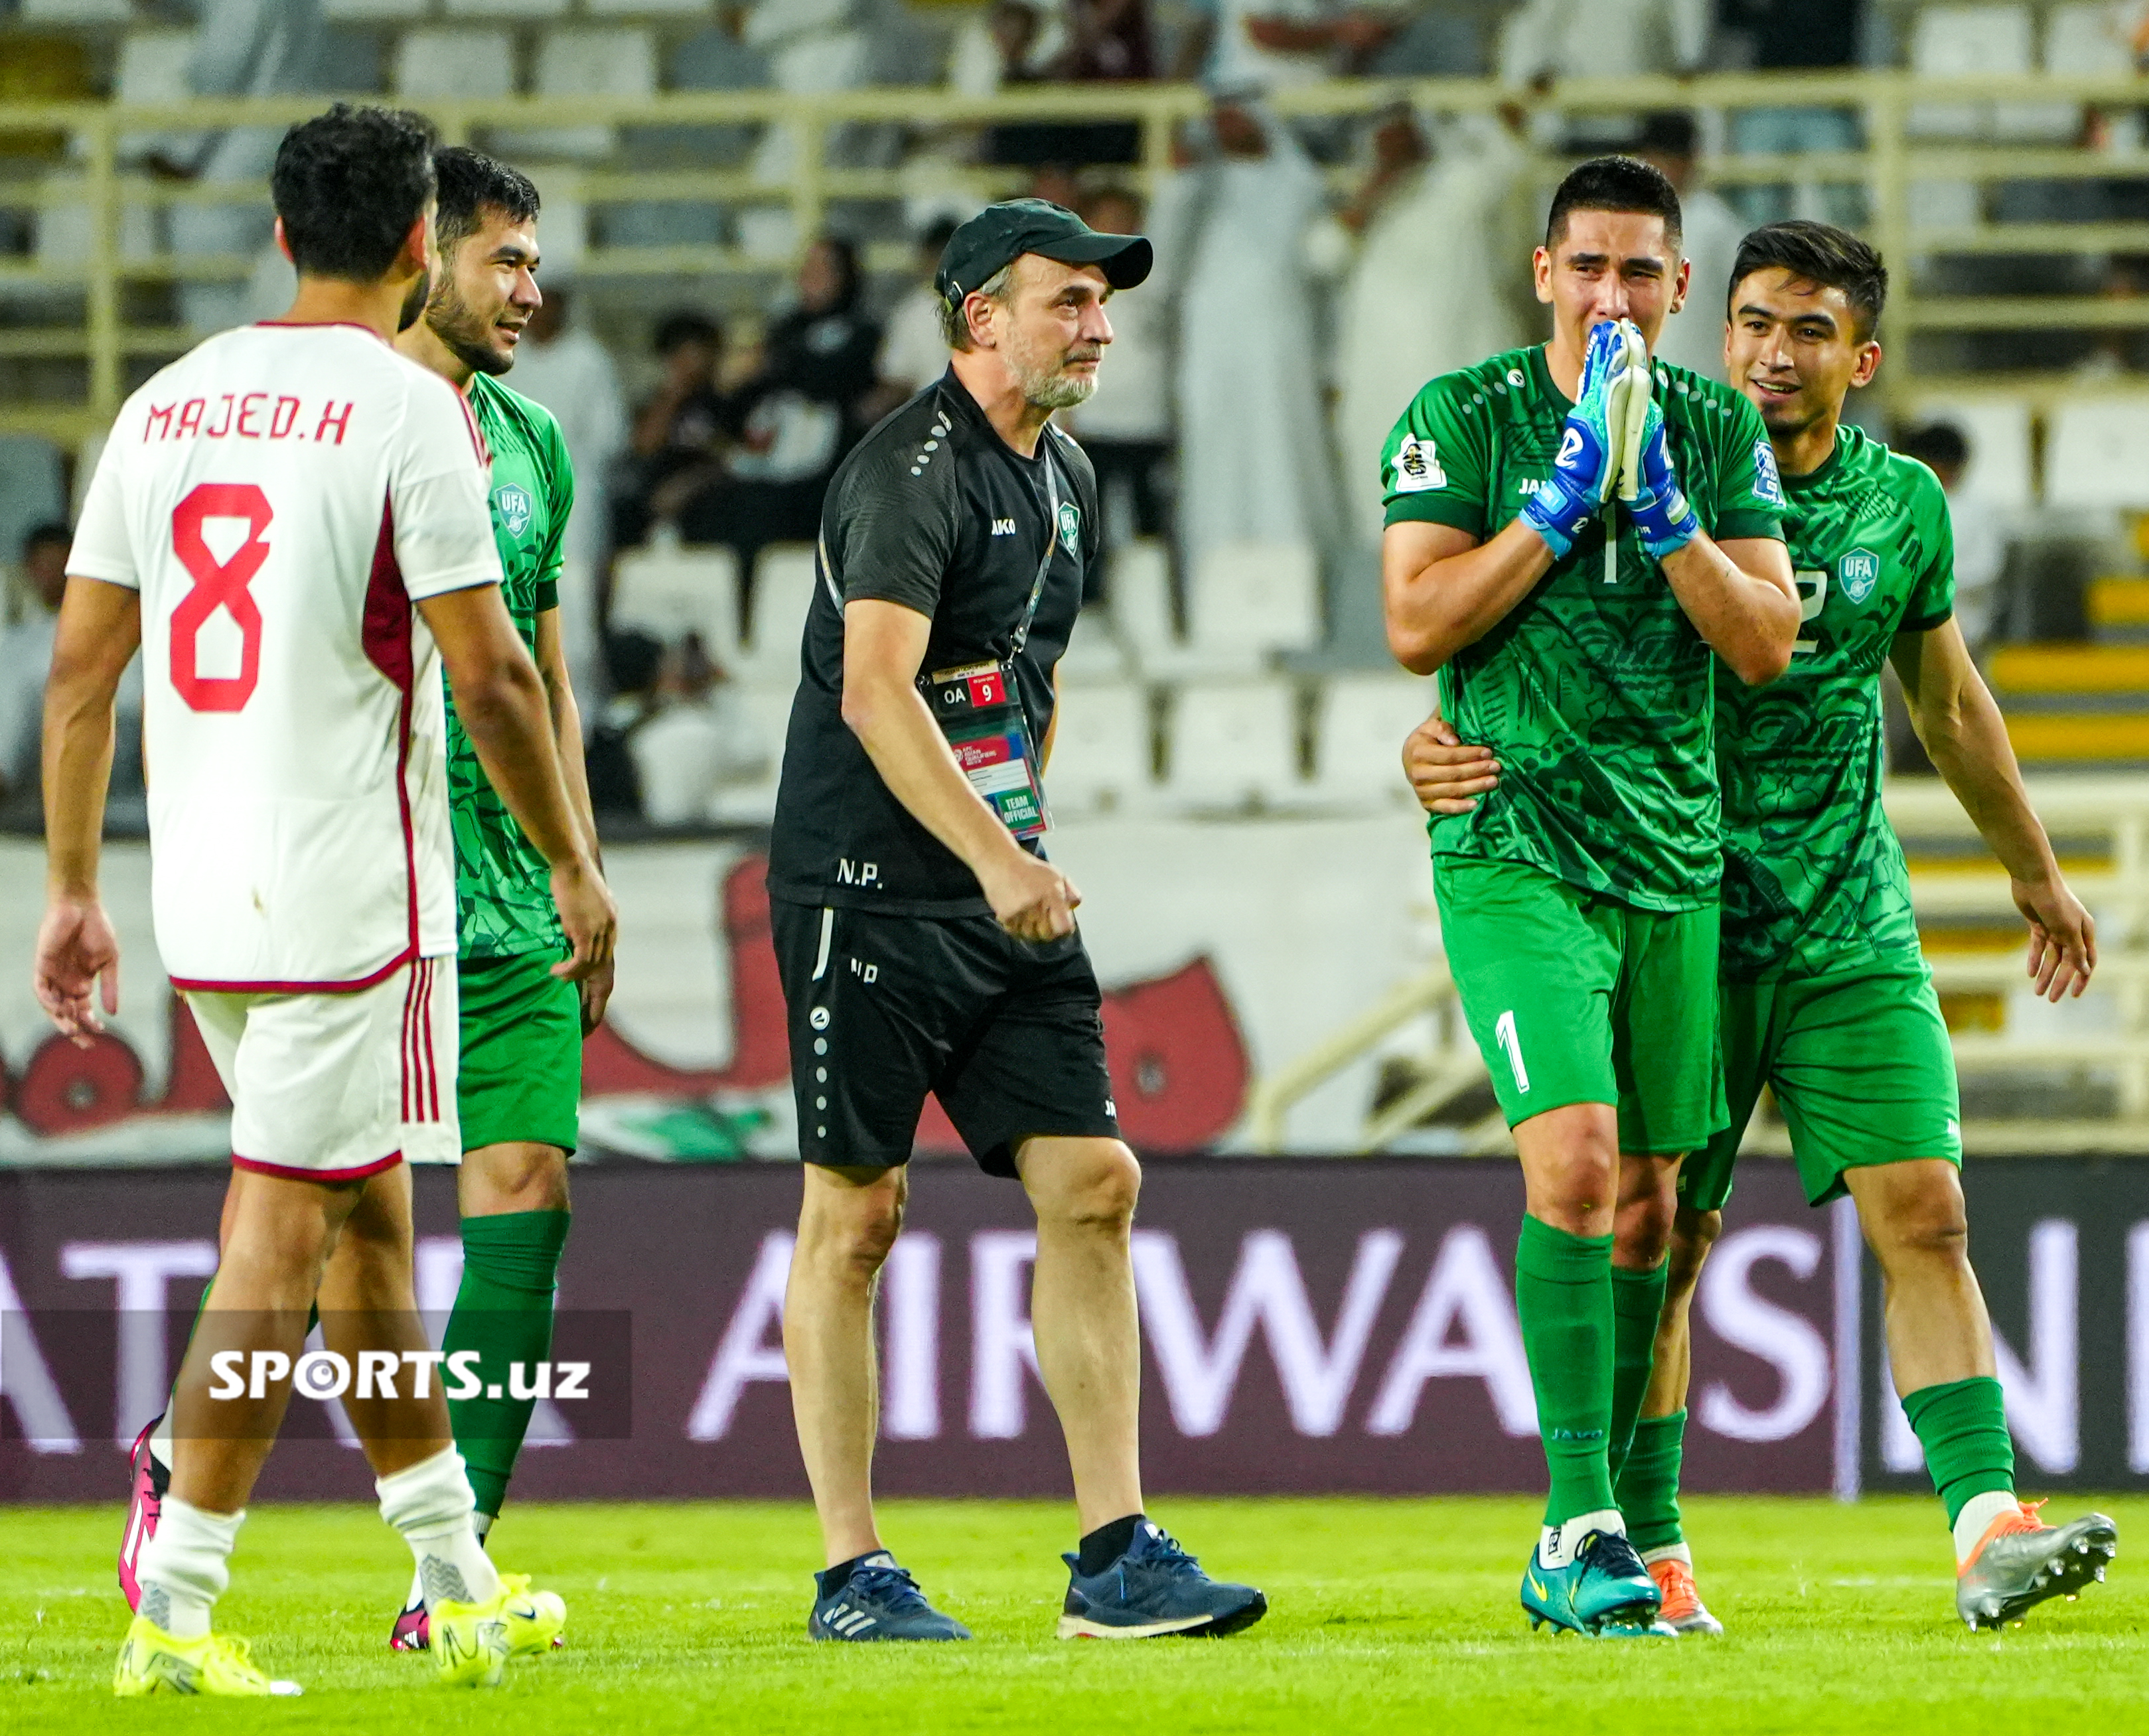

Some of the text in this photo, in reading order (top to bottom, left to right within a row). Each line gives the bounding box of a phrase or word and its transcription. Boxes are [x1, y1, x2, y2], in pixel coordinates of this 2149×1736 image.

[143, 393, 354, 445] MAJED.H
[1519, 477, 1548, 495] JA
[502, 493, 527, 514] UFA
[991, 518, 1016, 536] AKO
[1061, 512, 1076, 532] UFA
[1845, 558, 1872, 577] UFA
[169, 483, 273, 712] 8
[944, 684, 992, 704] OA 9
[1005, 795, 1029, 810] TEAM
[1003, 806, 1037, 824] OFFICIAL
[837, 858, 883, 890] N.P.
[1495, 1011, 1529, 1094] 1
[686, 1224, 1833, 1443] AIRWAS
